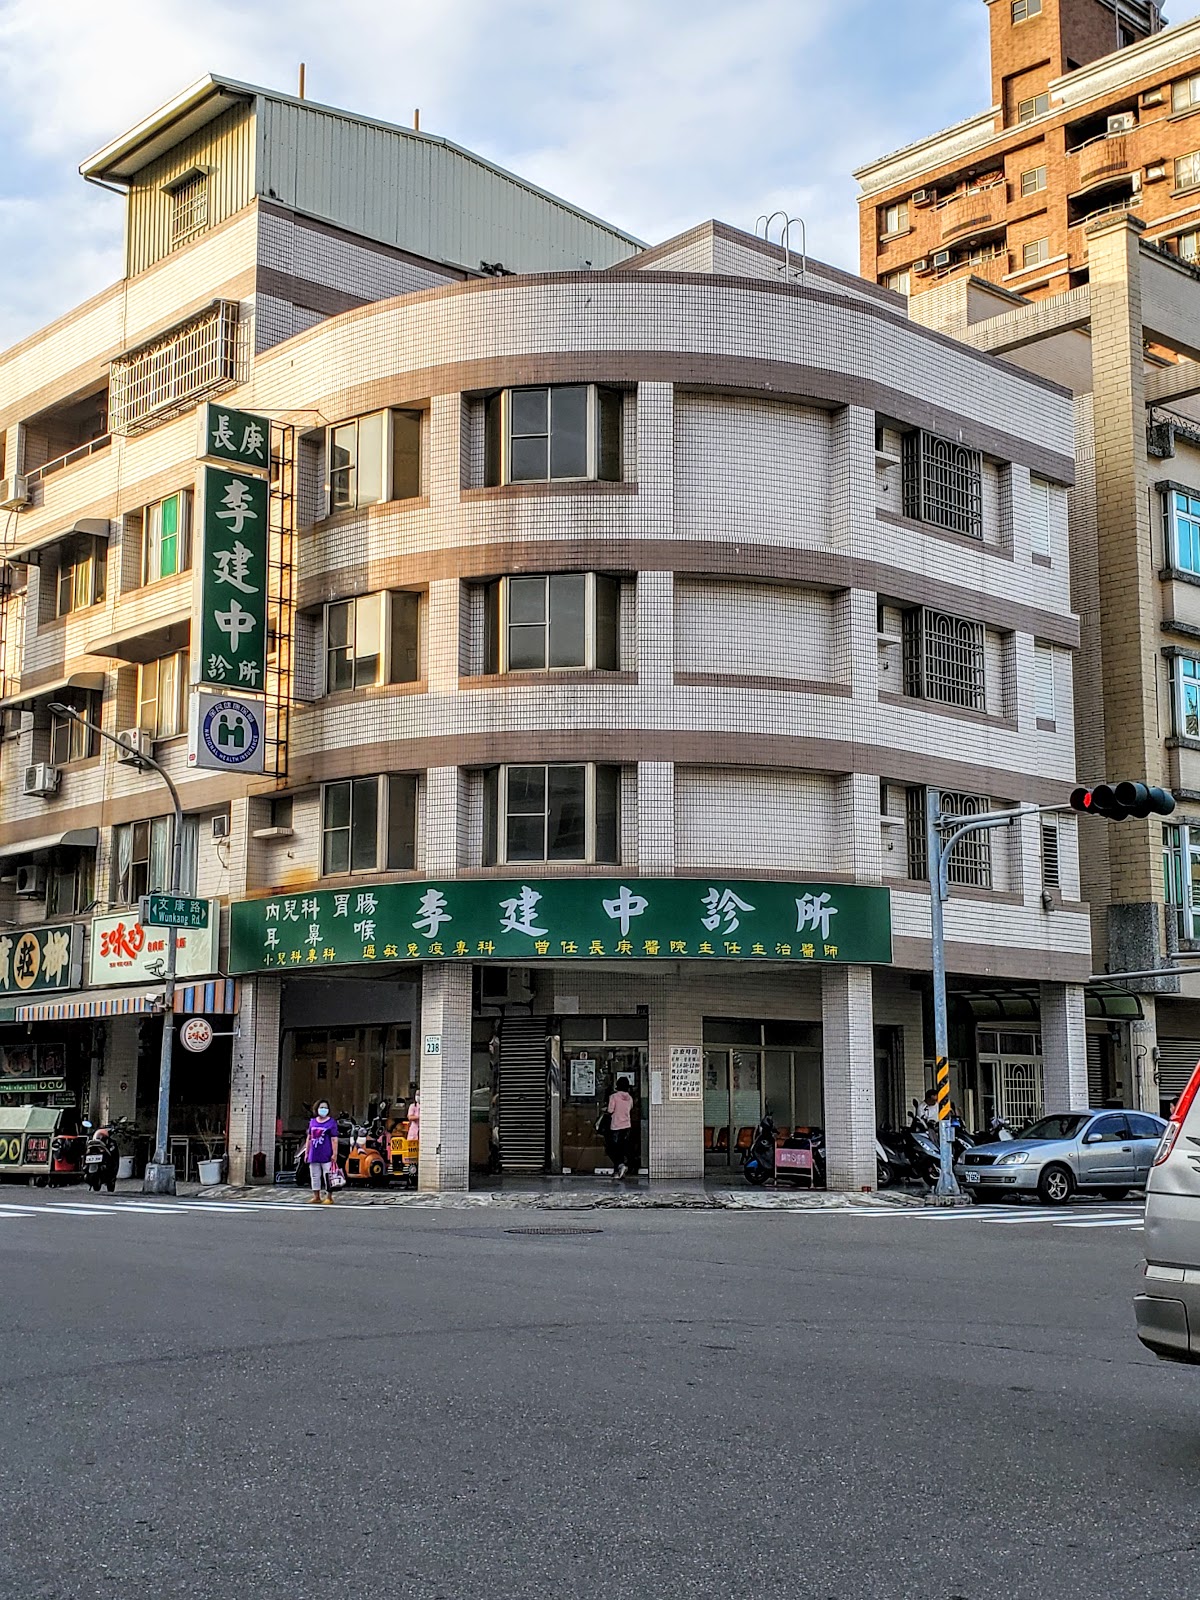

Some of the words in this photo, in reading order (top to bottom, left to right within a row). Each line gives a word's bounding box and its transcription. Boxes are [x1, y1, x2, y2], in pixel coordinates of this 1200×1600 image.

[212, 414, 264, 459] 長庚
[213, 479, 259, 653] 李建中
[207, 653, 261, 686] 診所
[204, 728, 219, 756] NATIONAL
[219, 754, 240, 763] HEALTH
[239, 735, 259, 760] INSURANCE
[158, 898, 200, 913] 文康路
[158, 911, 189, 926] Wunkang
[333, 893, 379, 918] 胃腸
[411, 885, 838, 940] 李建中診所
[264, 919, 377, 951] 耳鼻喉
[263, 947, 337, 966] 小兒科專科
[362, 940, 496, 960] 過敏免疫專科
[534, 939, 839, 959] 曾任長庚醫院主任主治醫師
[426, 1042, 440, 1053] 238
